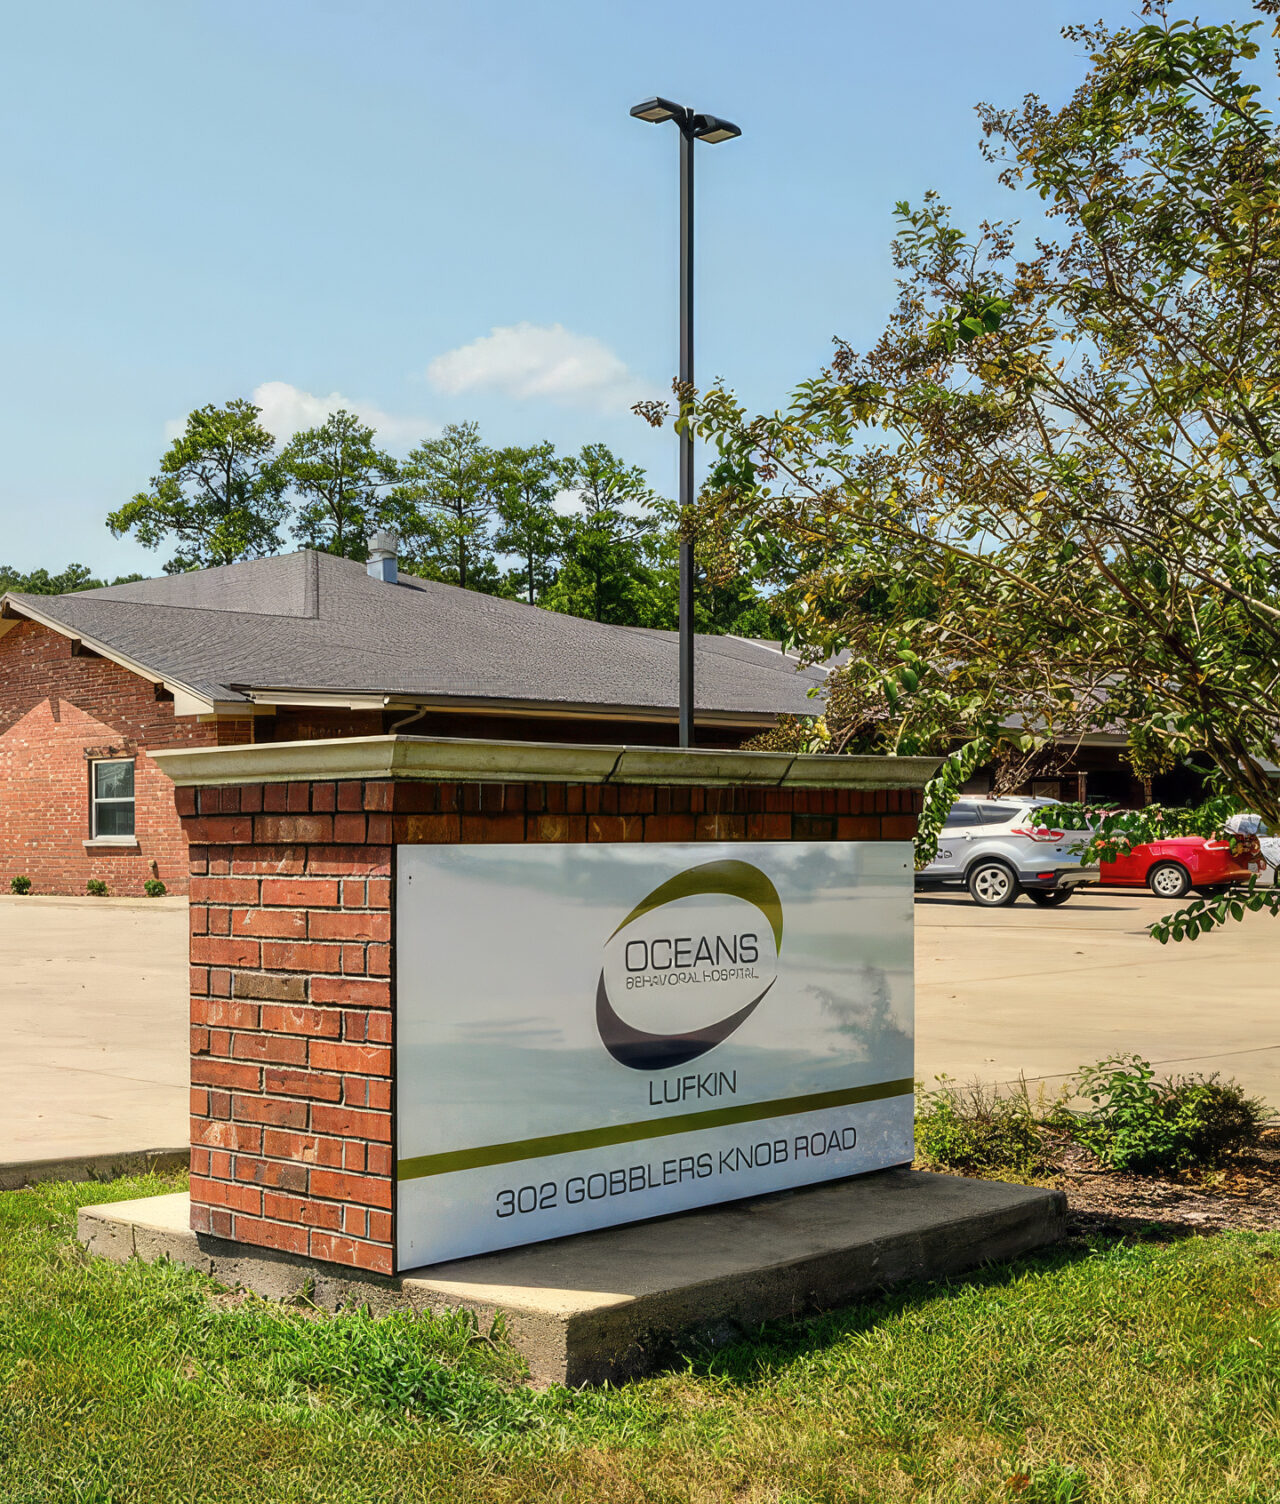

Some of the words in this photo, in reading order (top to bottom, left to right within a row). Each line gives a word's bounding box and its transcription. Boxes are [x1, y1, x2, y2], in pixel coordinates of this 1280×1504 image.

[625, 933, 759, 972] OCEANS
[649, 1070, 737, 1106] LUFKIN
[496, 1182, 557, 1218] 302
[565, 1153, 713, 1205] GOBBLERS
[719, 1139, 788, 1175] KNOB
[794, 1127, 857, 1161] ROAD
